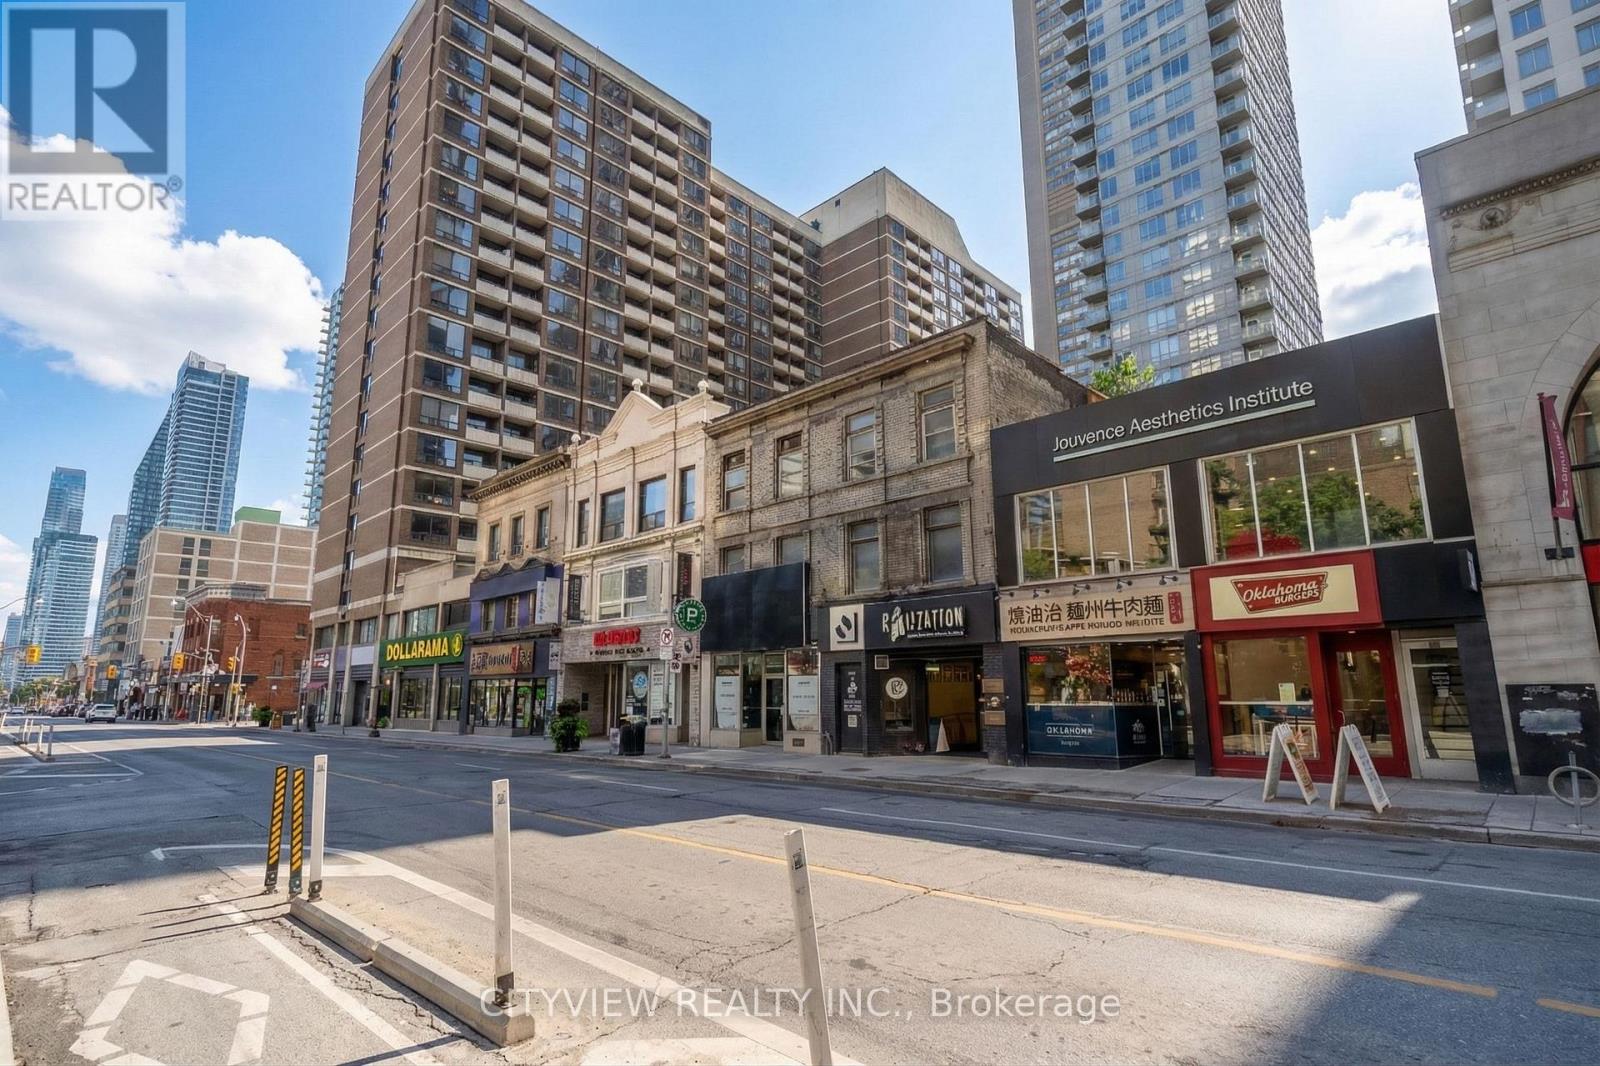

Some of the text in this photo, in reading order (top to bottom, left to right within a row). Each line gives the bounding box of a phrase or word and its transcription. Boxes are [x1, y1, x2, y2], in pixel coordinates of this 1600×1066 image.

[1053, 380, 1314, 452] Jouvence Aesthetics Institute
[1243, 580, 1319, 603] Oklahoma
[686, 607, 698, 622] P
[386, 637, 449, 661] DOLLARAMA
